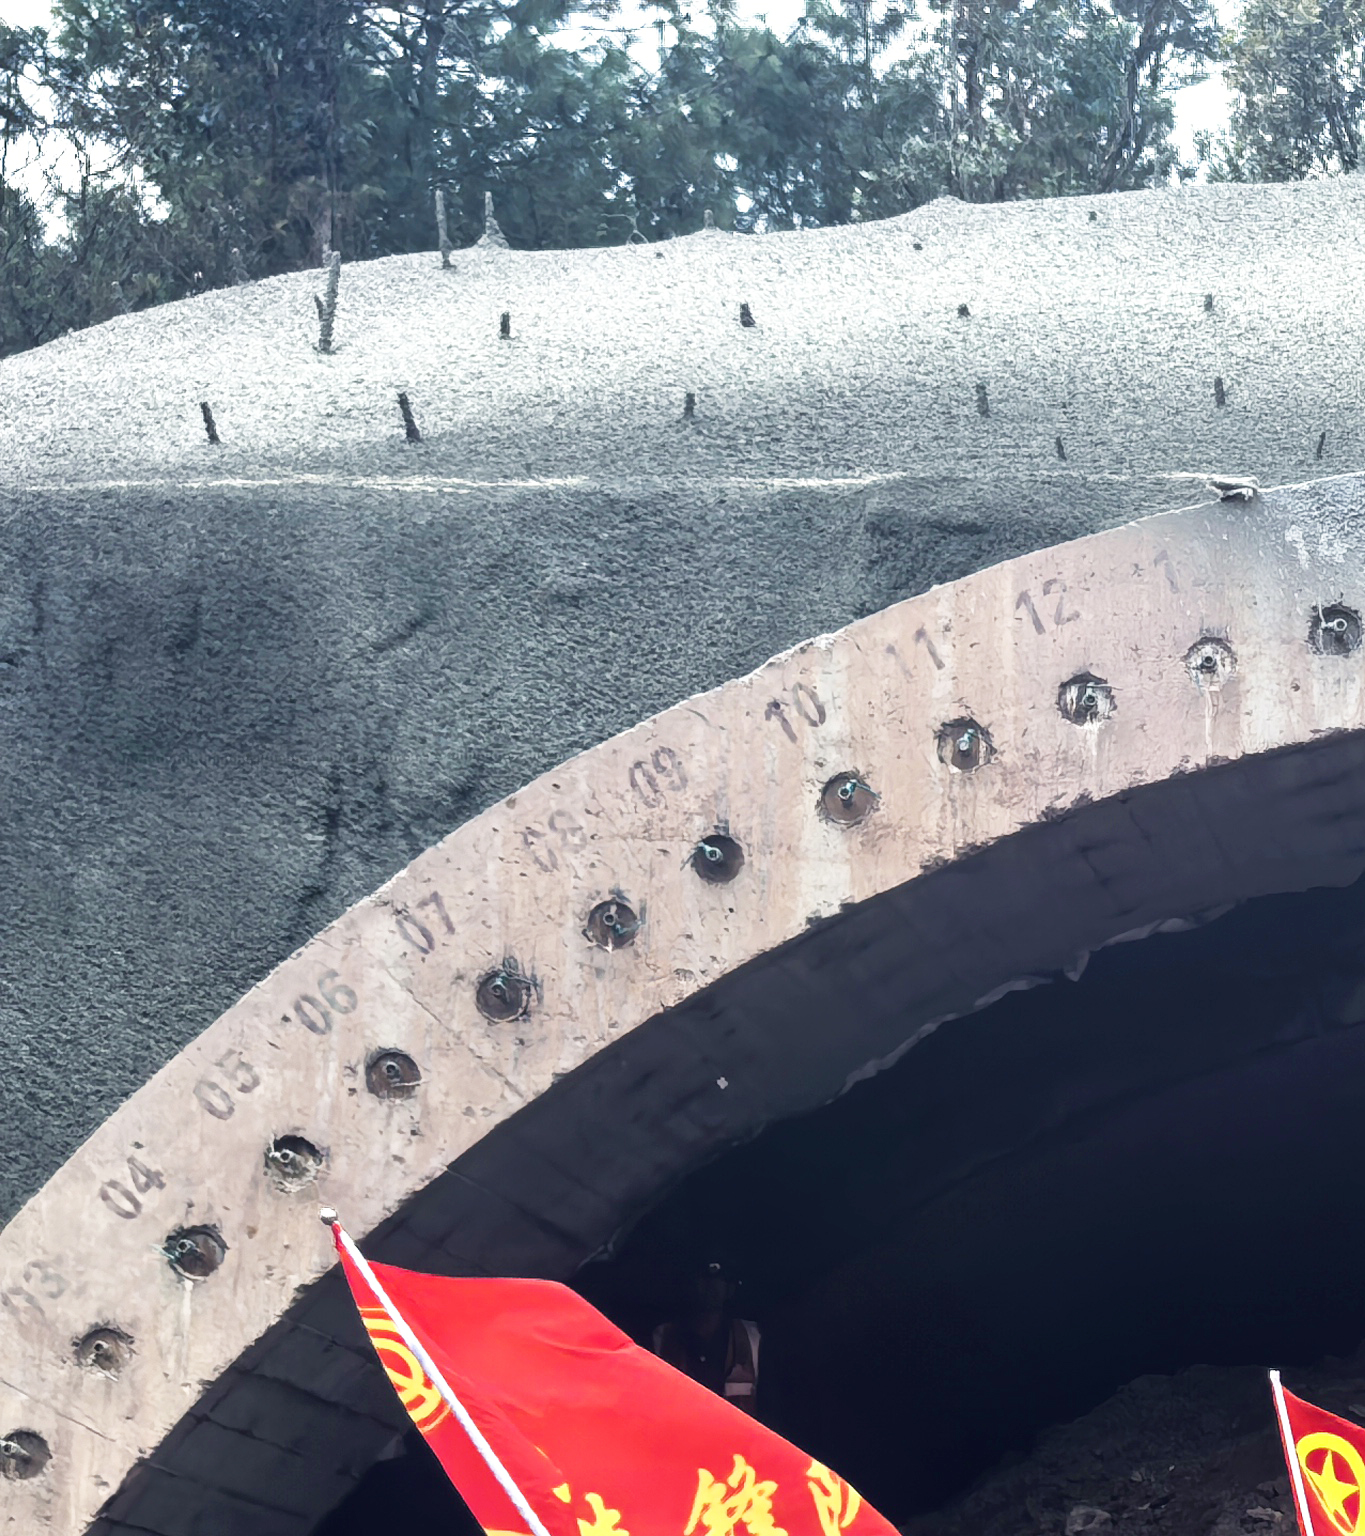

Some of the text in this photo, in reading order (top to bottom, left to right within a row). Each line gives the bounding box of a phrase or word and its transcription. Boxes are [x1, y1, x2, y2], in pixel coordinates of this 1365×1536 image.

[1015, 578, 1080, 636] 12
[763, 682, 827, 744] 10
[628, 745, 690, 811] 09
[400, 890, 457, 957] 07
[292, 967, 359, 1038] 06
[193, 1048, 261, 1122] 05
[100, 1154, 167, 1221] 04
